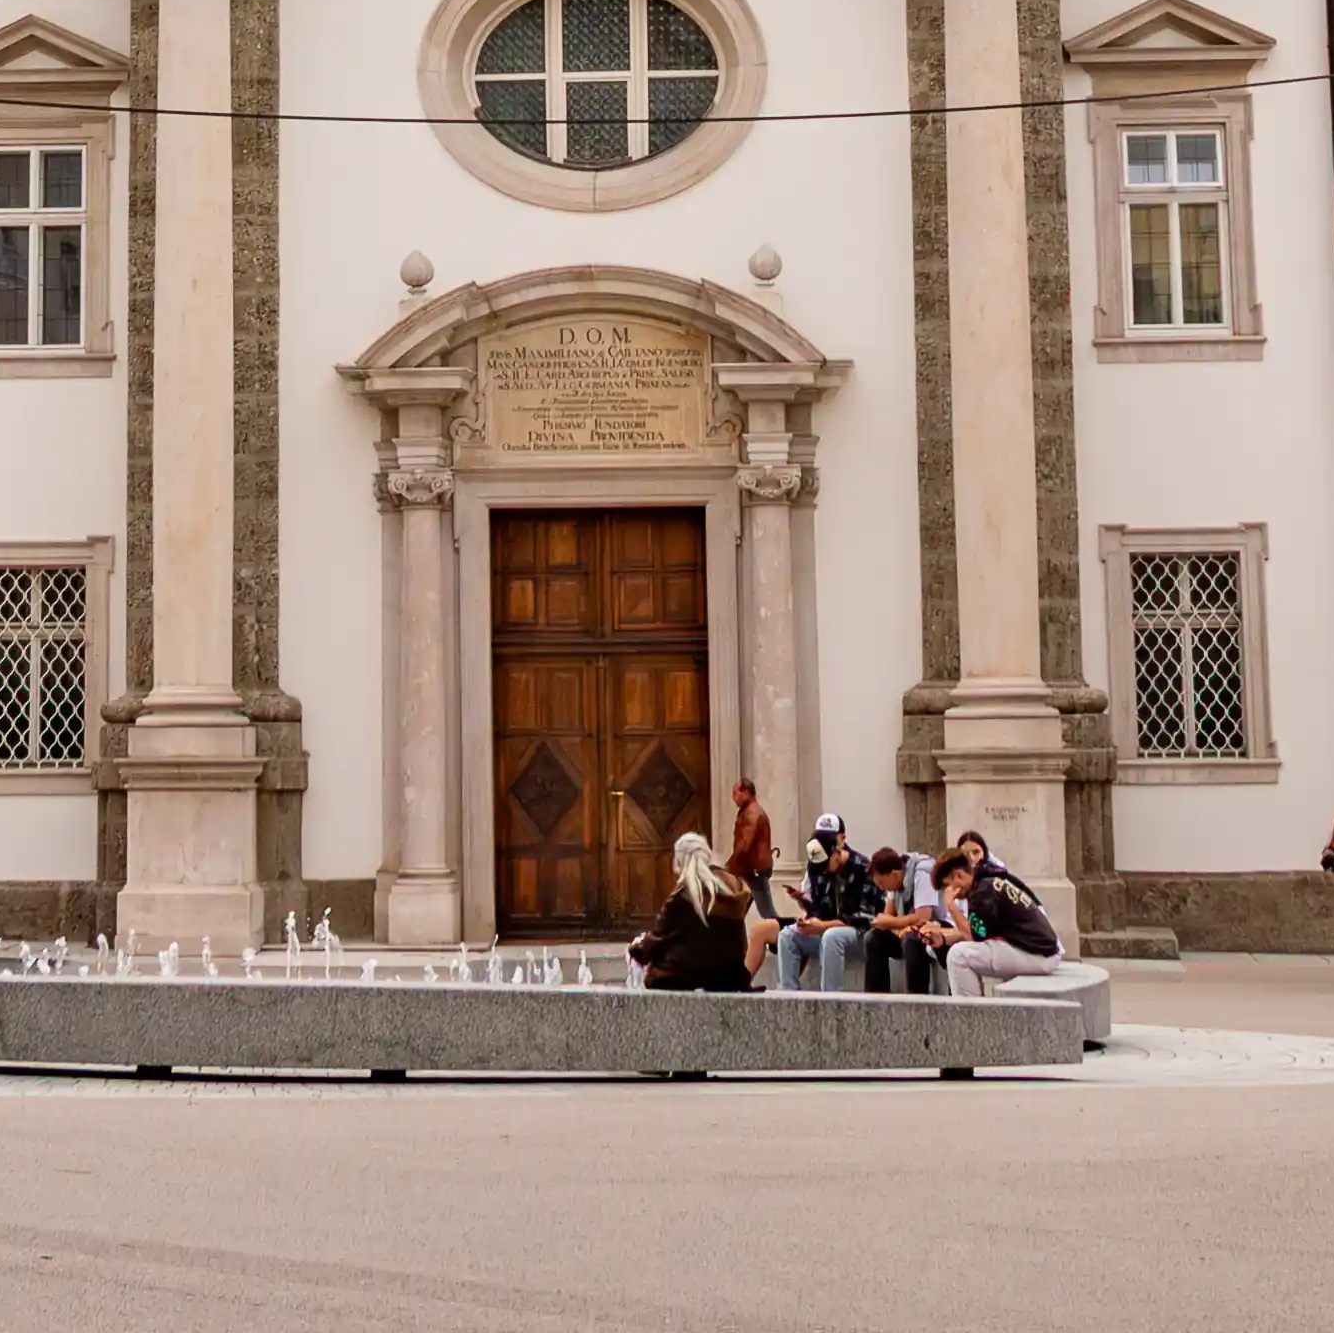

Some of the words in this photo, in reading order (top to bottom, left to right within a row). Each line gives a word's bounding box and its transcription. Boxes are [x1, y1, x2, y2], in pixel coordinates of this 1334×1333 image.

[559, 327, 577, 345] D.
[585, 327, 605, 345] O.
[612, 326, 632, 344] M.
